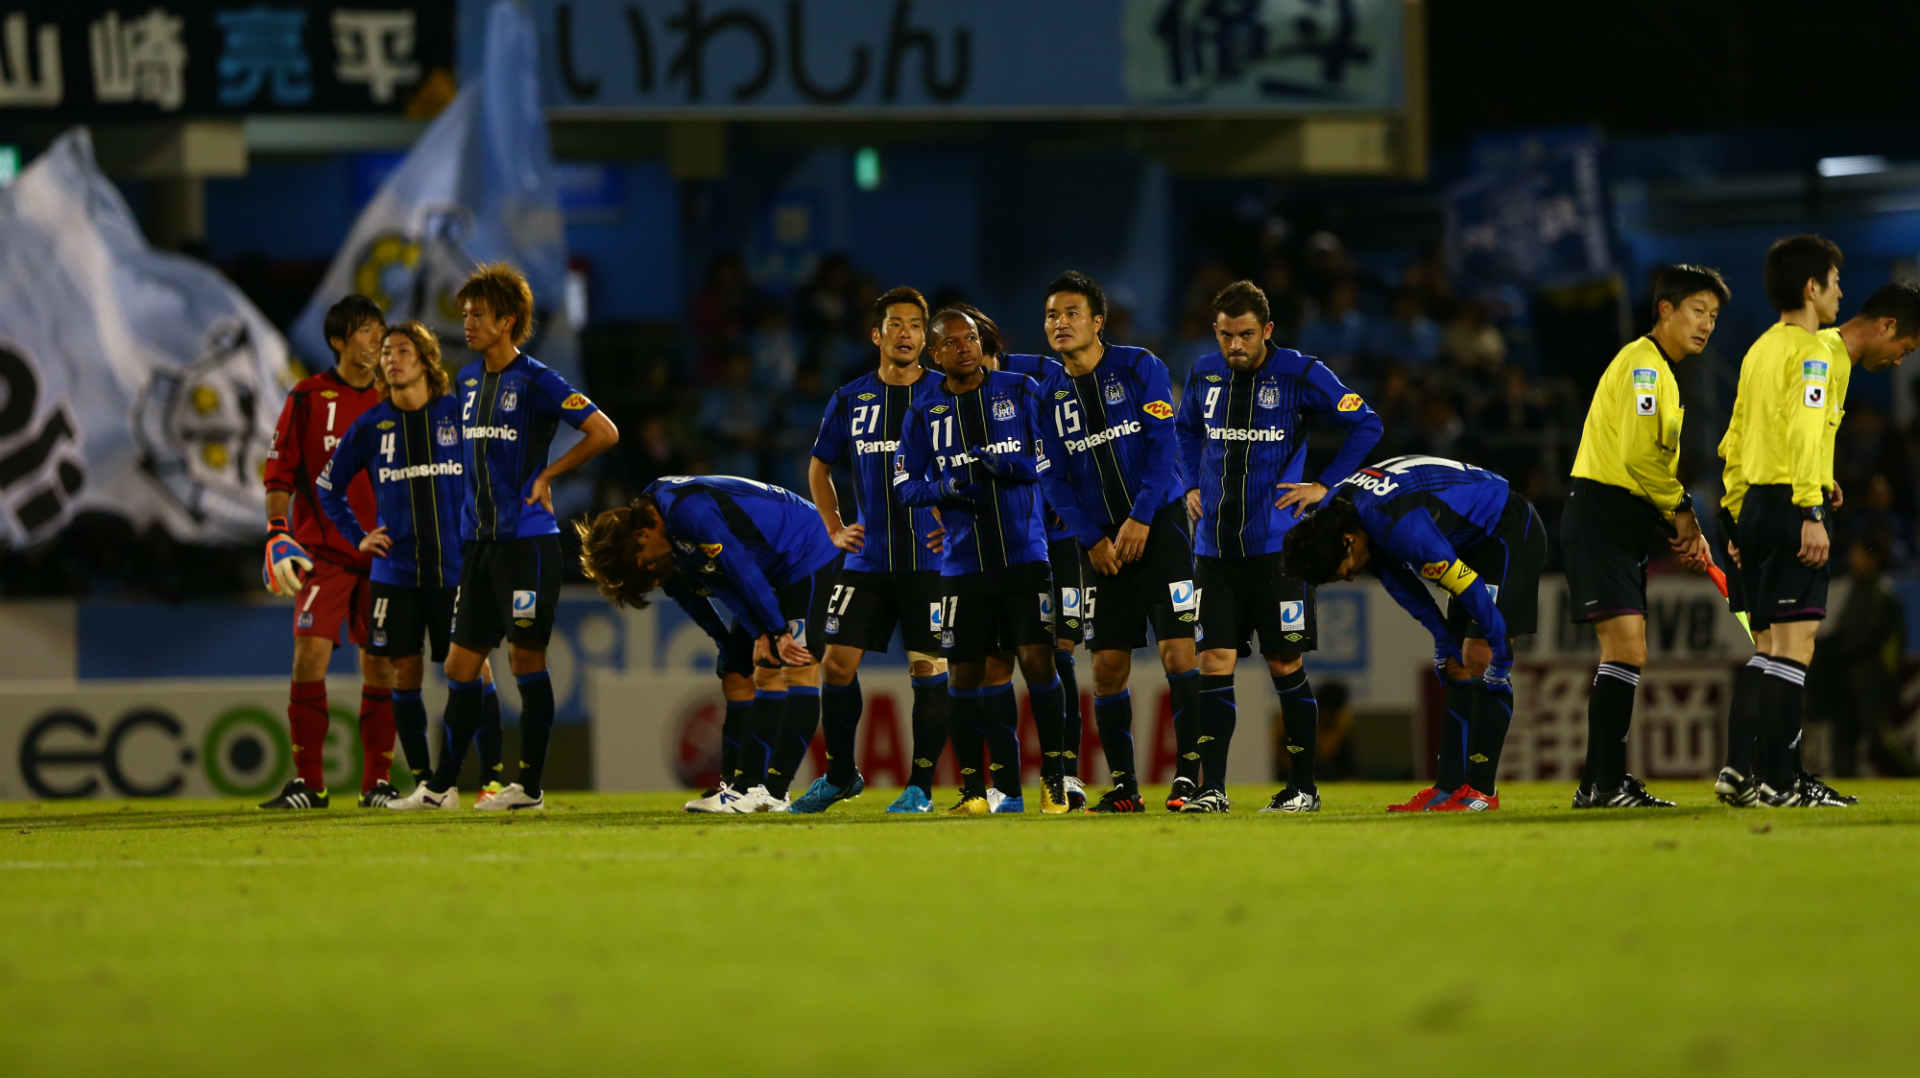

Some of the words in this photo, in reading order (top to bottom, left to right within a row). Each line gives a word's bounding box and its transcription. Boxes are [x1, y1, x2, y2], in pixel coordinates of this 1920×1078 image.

[556, 0, 972, 104] いわしん
[327, 402, 337, 431] 1
[462, 390, 477, 420] 2
[1203, 386, 1222, 418] 9
[851, 404, 881, 437] 21
[931, 415, 953, 452] 11
[1055, 399, 1081, 438] 15
[380, 432, 396, 463] 4
[379, 459, 463, 484] Panasonic
[302, 585, 320, 612] 1
[373, 598, 388, 628] 4
[827, 584, 856, 616] 21
